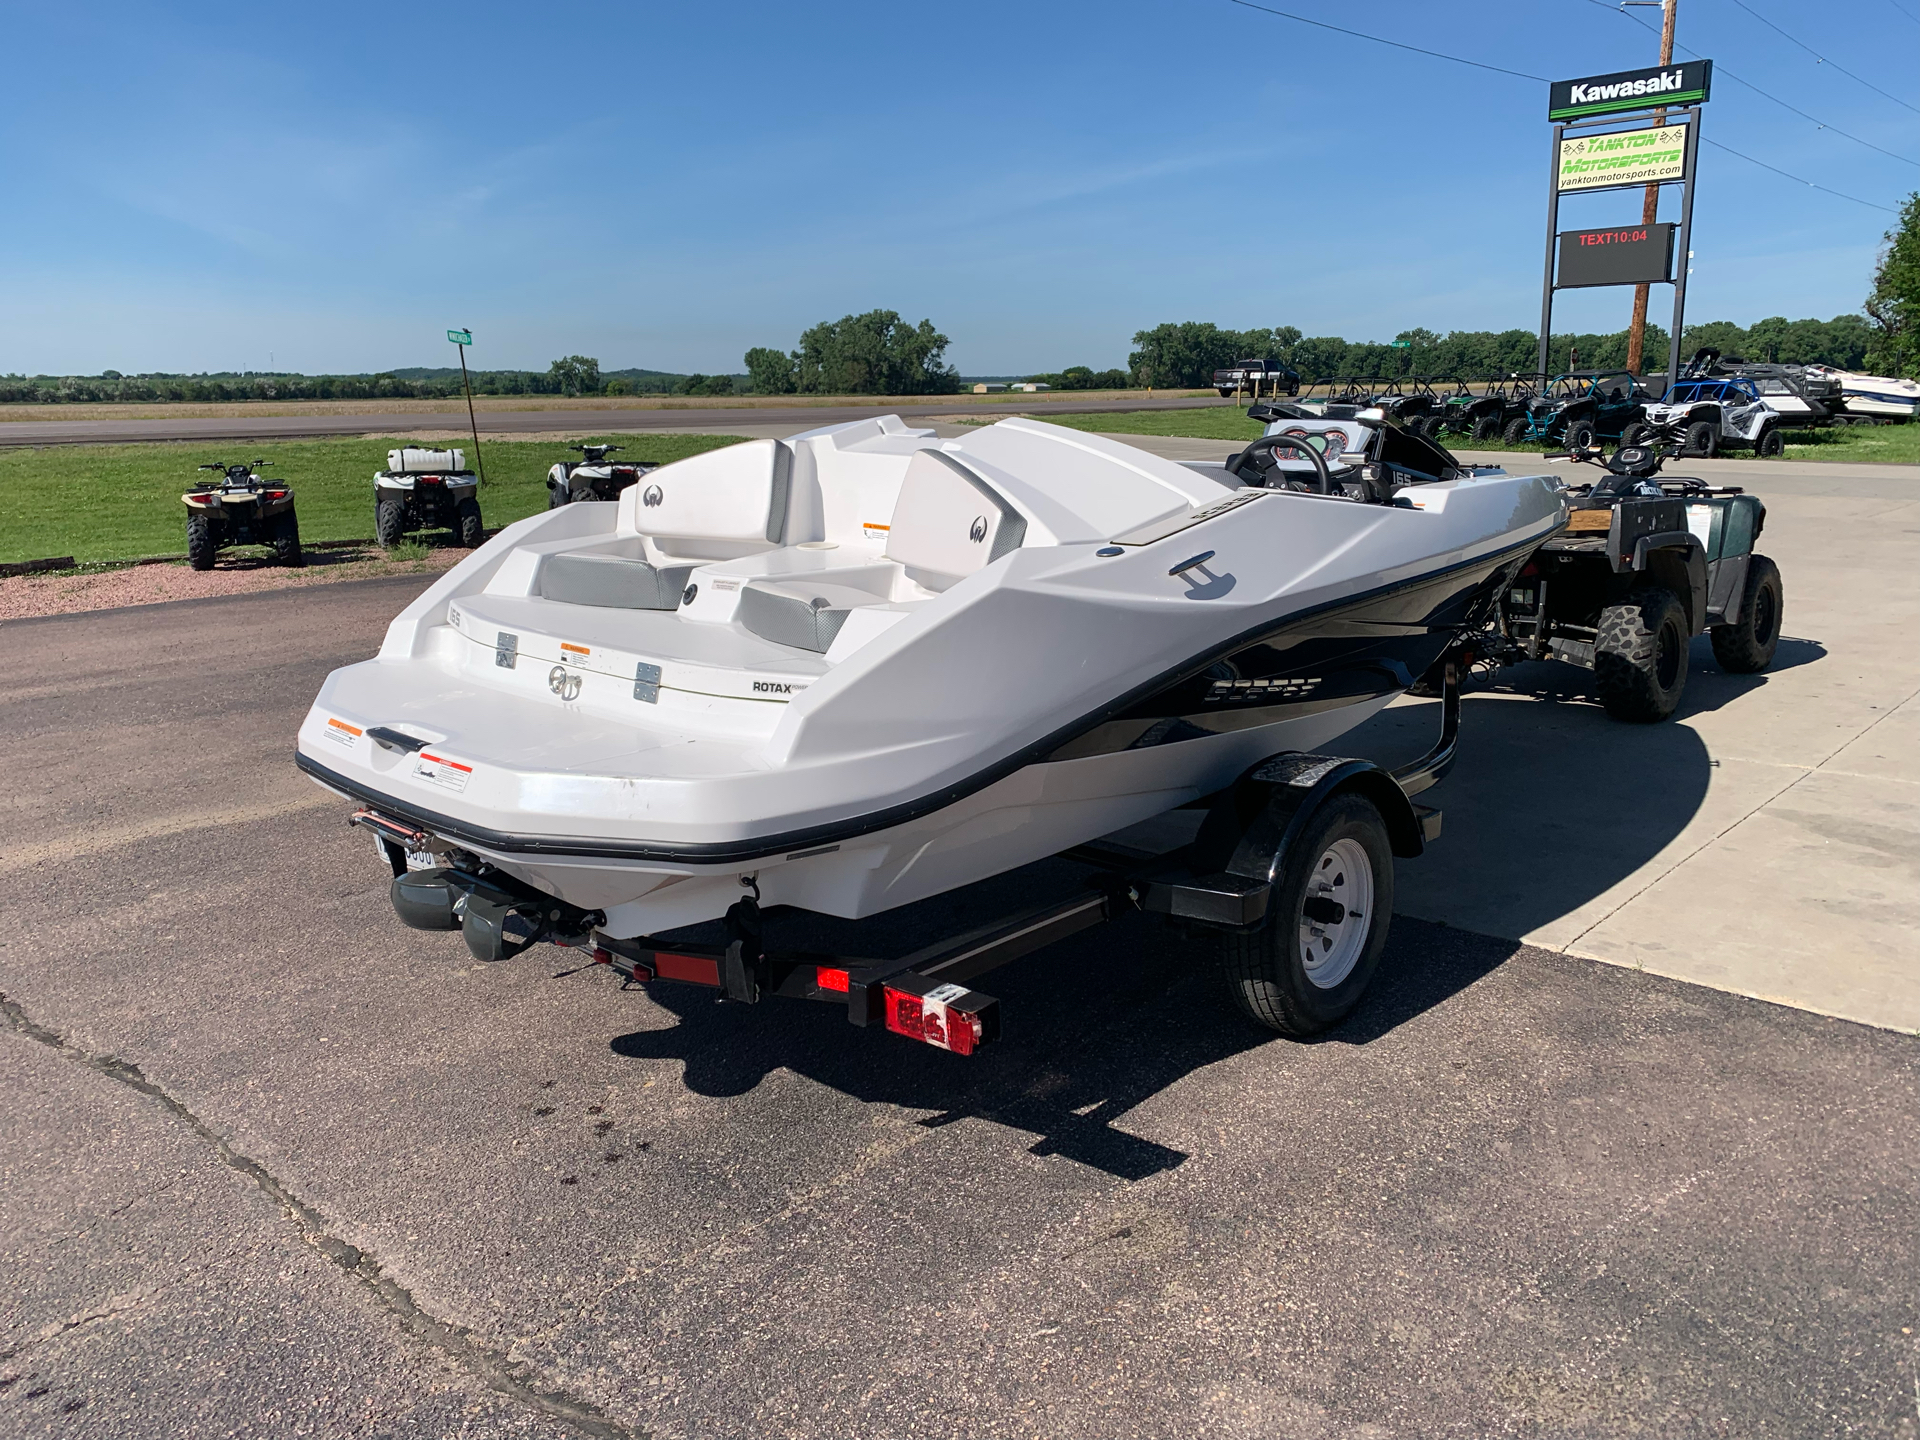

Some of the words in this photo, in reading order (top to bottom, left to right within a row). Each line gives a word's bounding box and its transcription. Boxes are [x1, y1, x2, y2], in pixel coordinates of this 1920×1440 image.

[1570, 69, 1683, 104] Kawasaki
[1587, 132, 1659, 153] YANKTON
[1561, 149, 1682, 174] MOTORSPORTS
[1560, 165, 1681, 188] yanktonmotorsports.com
[1392, 470, 1412, 487] 165
[450, 606, 460, 627] 165
[753, 682, 791, 693] ROTAX
